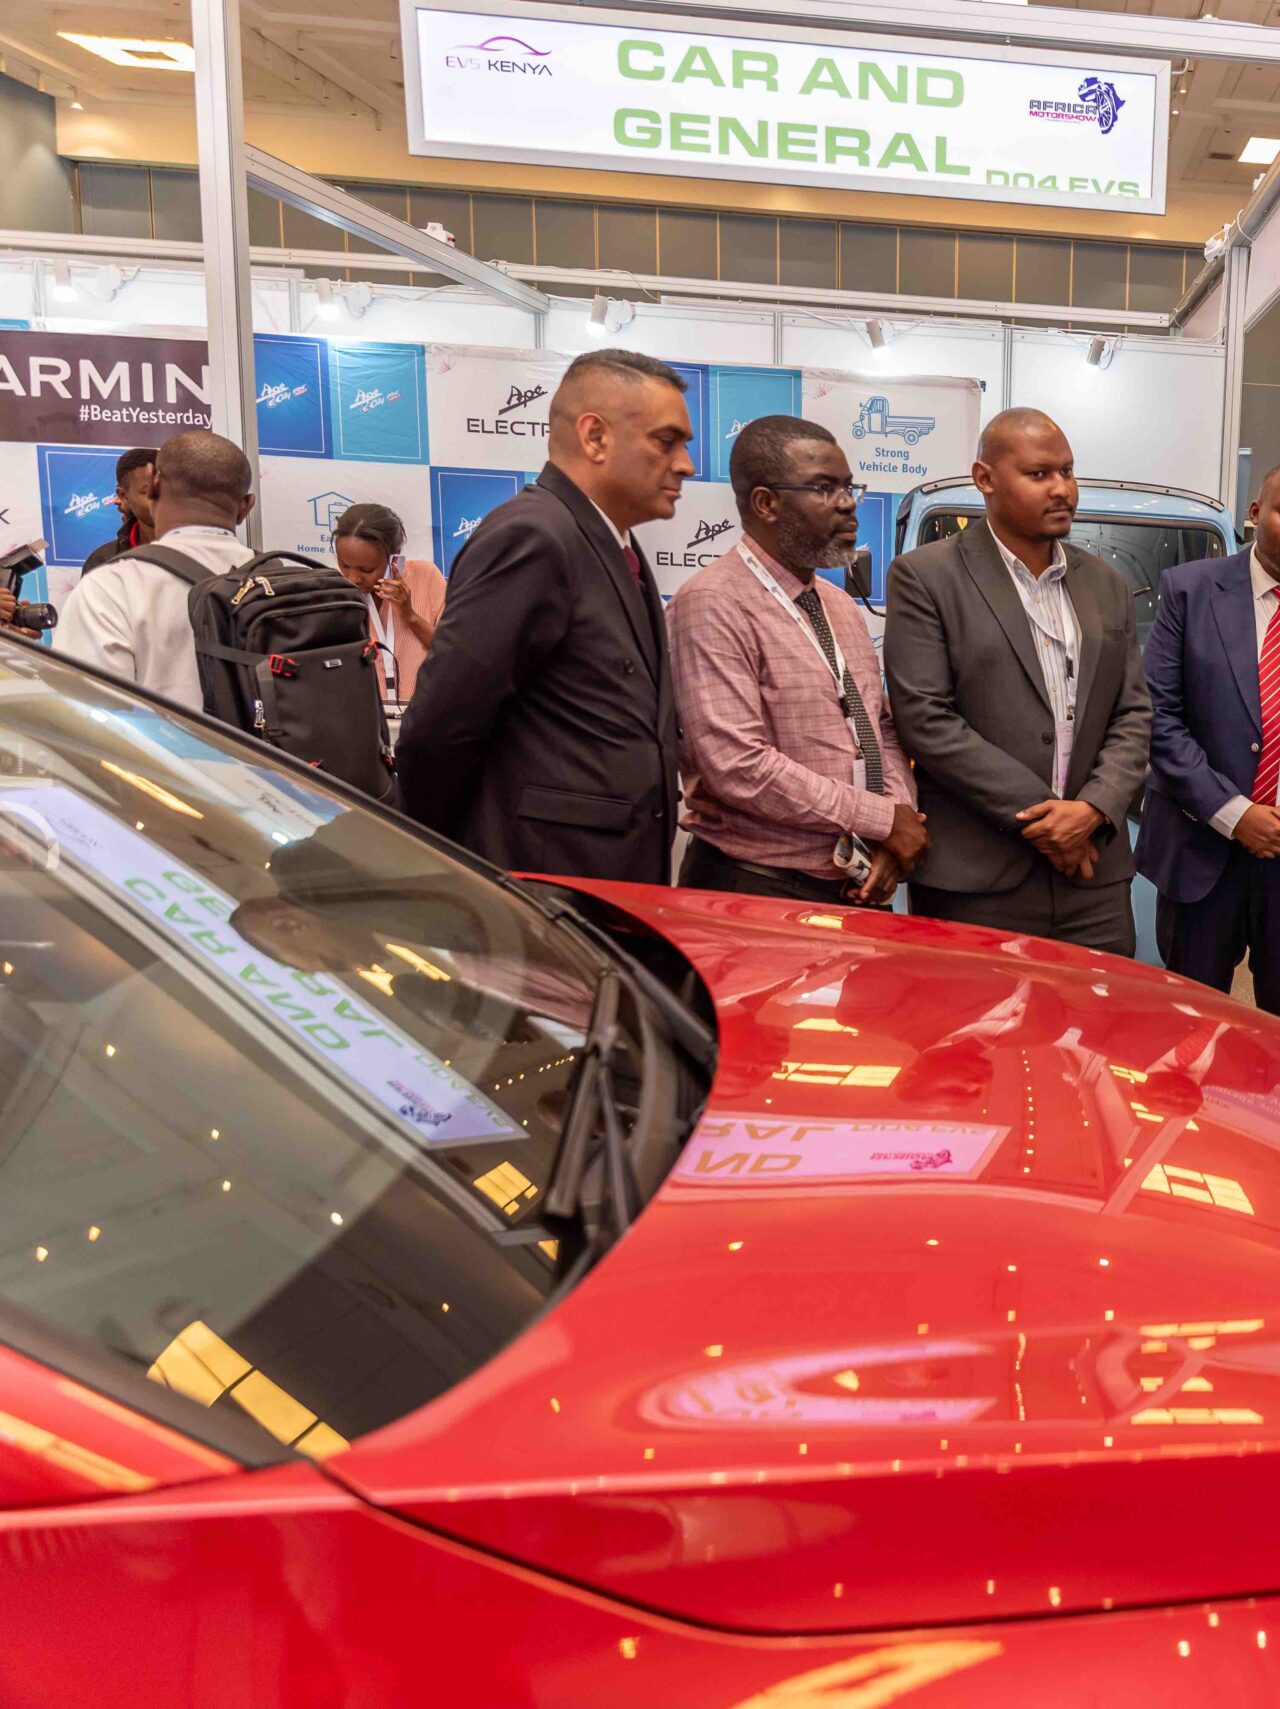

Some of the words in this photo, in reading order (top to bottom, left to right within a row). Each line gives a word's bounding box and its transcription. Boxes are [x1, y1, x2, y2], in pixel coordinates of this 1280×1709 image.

[446, 55, 480, 70] EVS
[488, 59, 553, 77] KENYA
[617, 38, 779, 92] CAR
[798, 58, 966, 109] AND
[1029, 99, 1097, 115] AFRICA
[1029, 110, 1097, 122] MOTORSHOW
[612, 108, 972, 177] GENERAL
[79, 404, 213, 430] #BeatYesterday
[874, 446, 910, 461] Strong
[859, 461, 899, 474] Vehicle
[901, 463, 929, 477] Body
[297, 544, 326, 554] Home
